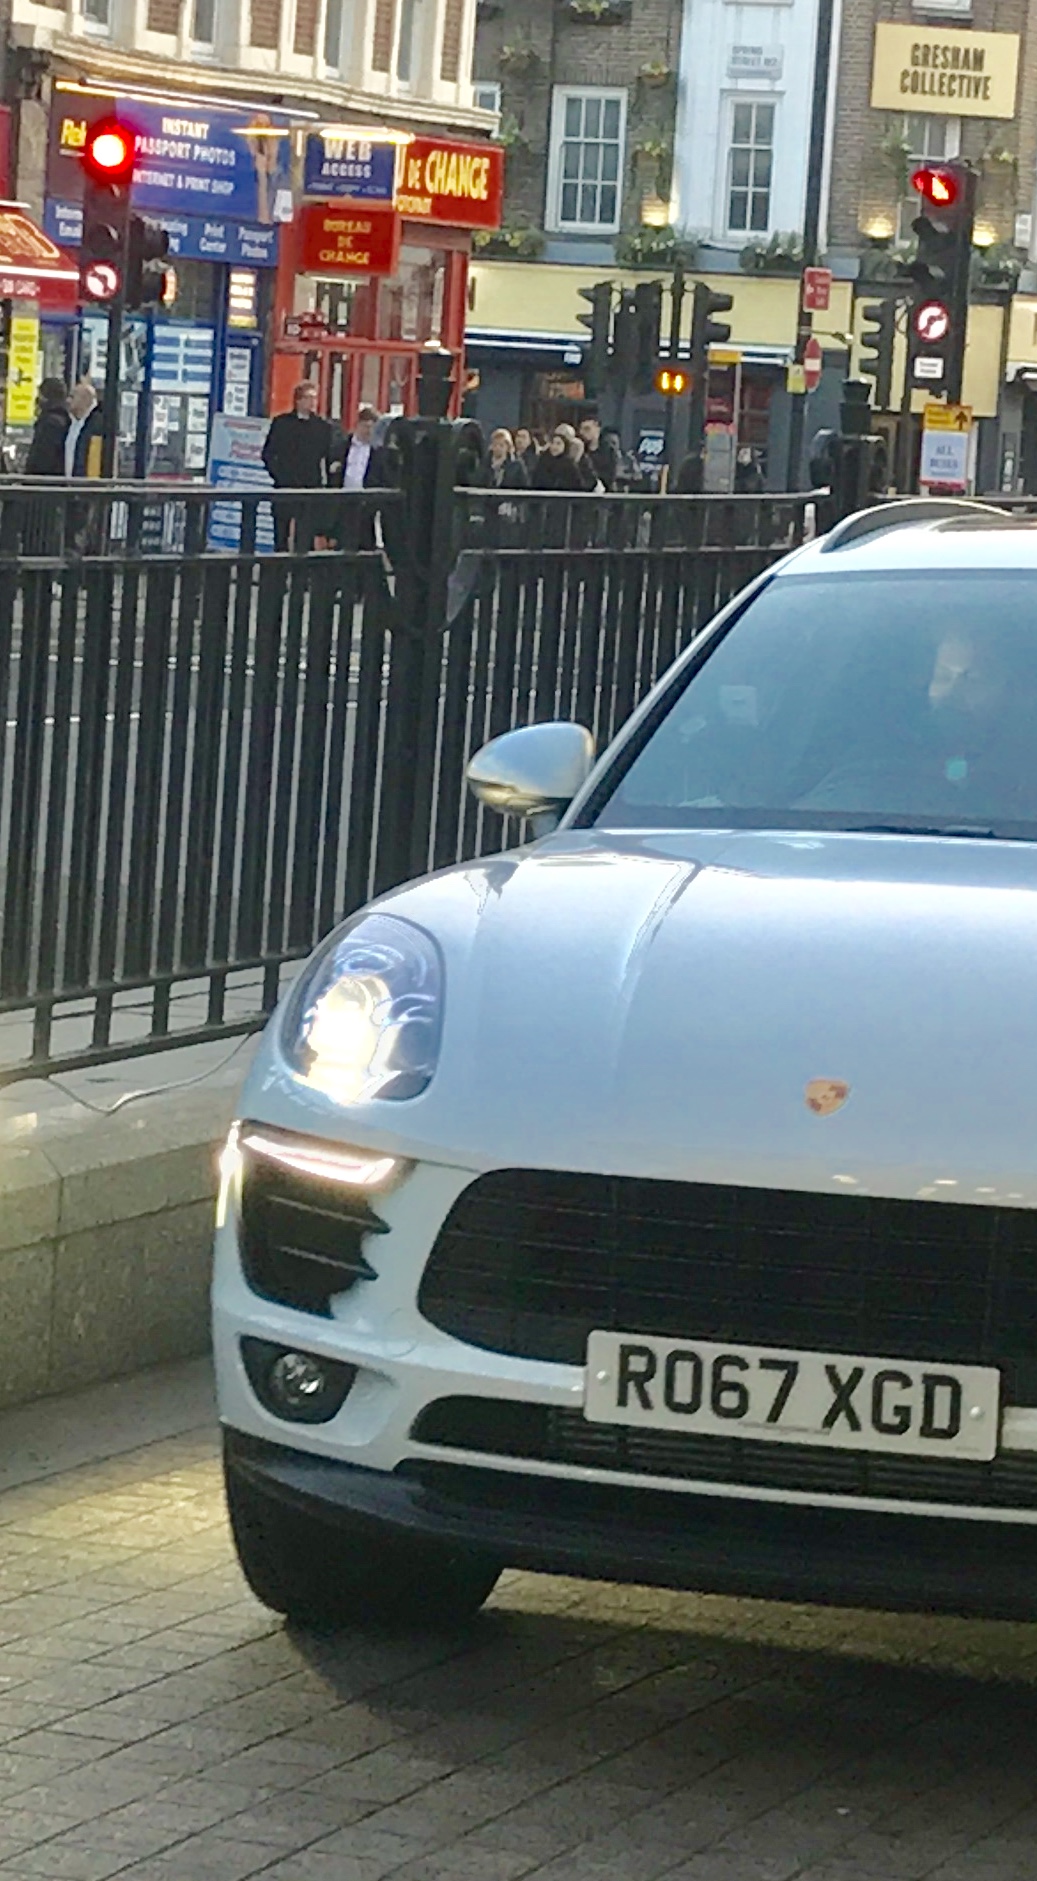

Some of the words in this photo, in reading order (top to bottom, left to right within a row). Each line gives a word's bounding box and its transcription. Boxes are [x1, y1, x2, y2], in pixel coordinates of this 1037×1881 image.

[910, 42, 985, 72] GRESHAM
[899, 69, 992, 100] COLLECTIVE
[161, 117, 210, 140] INSTANT
[134, 135, 191, 160] PASSPORT
[193, 143, 236, 166] PHOTOS
[323, 140, 372, 162] WEB
[132, 168, 175, 187] INTERNET
[185, 174, 210, 193] PRINT
[211, 179, 235, 196] SHOP
[321, 162, 372, 178] ACCESS
[407, 158, 421, 189] DE
[425, 150, 490, 200] CHANGE
[323, 219, 372, 234] BUREAU
[337, 235, 353, 249] DE
[319, 250, 370, 265] CHANGE
[616, 1343, 799, 1424] RO67
[821, 1364, 962, 1440] XGD
